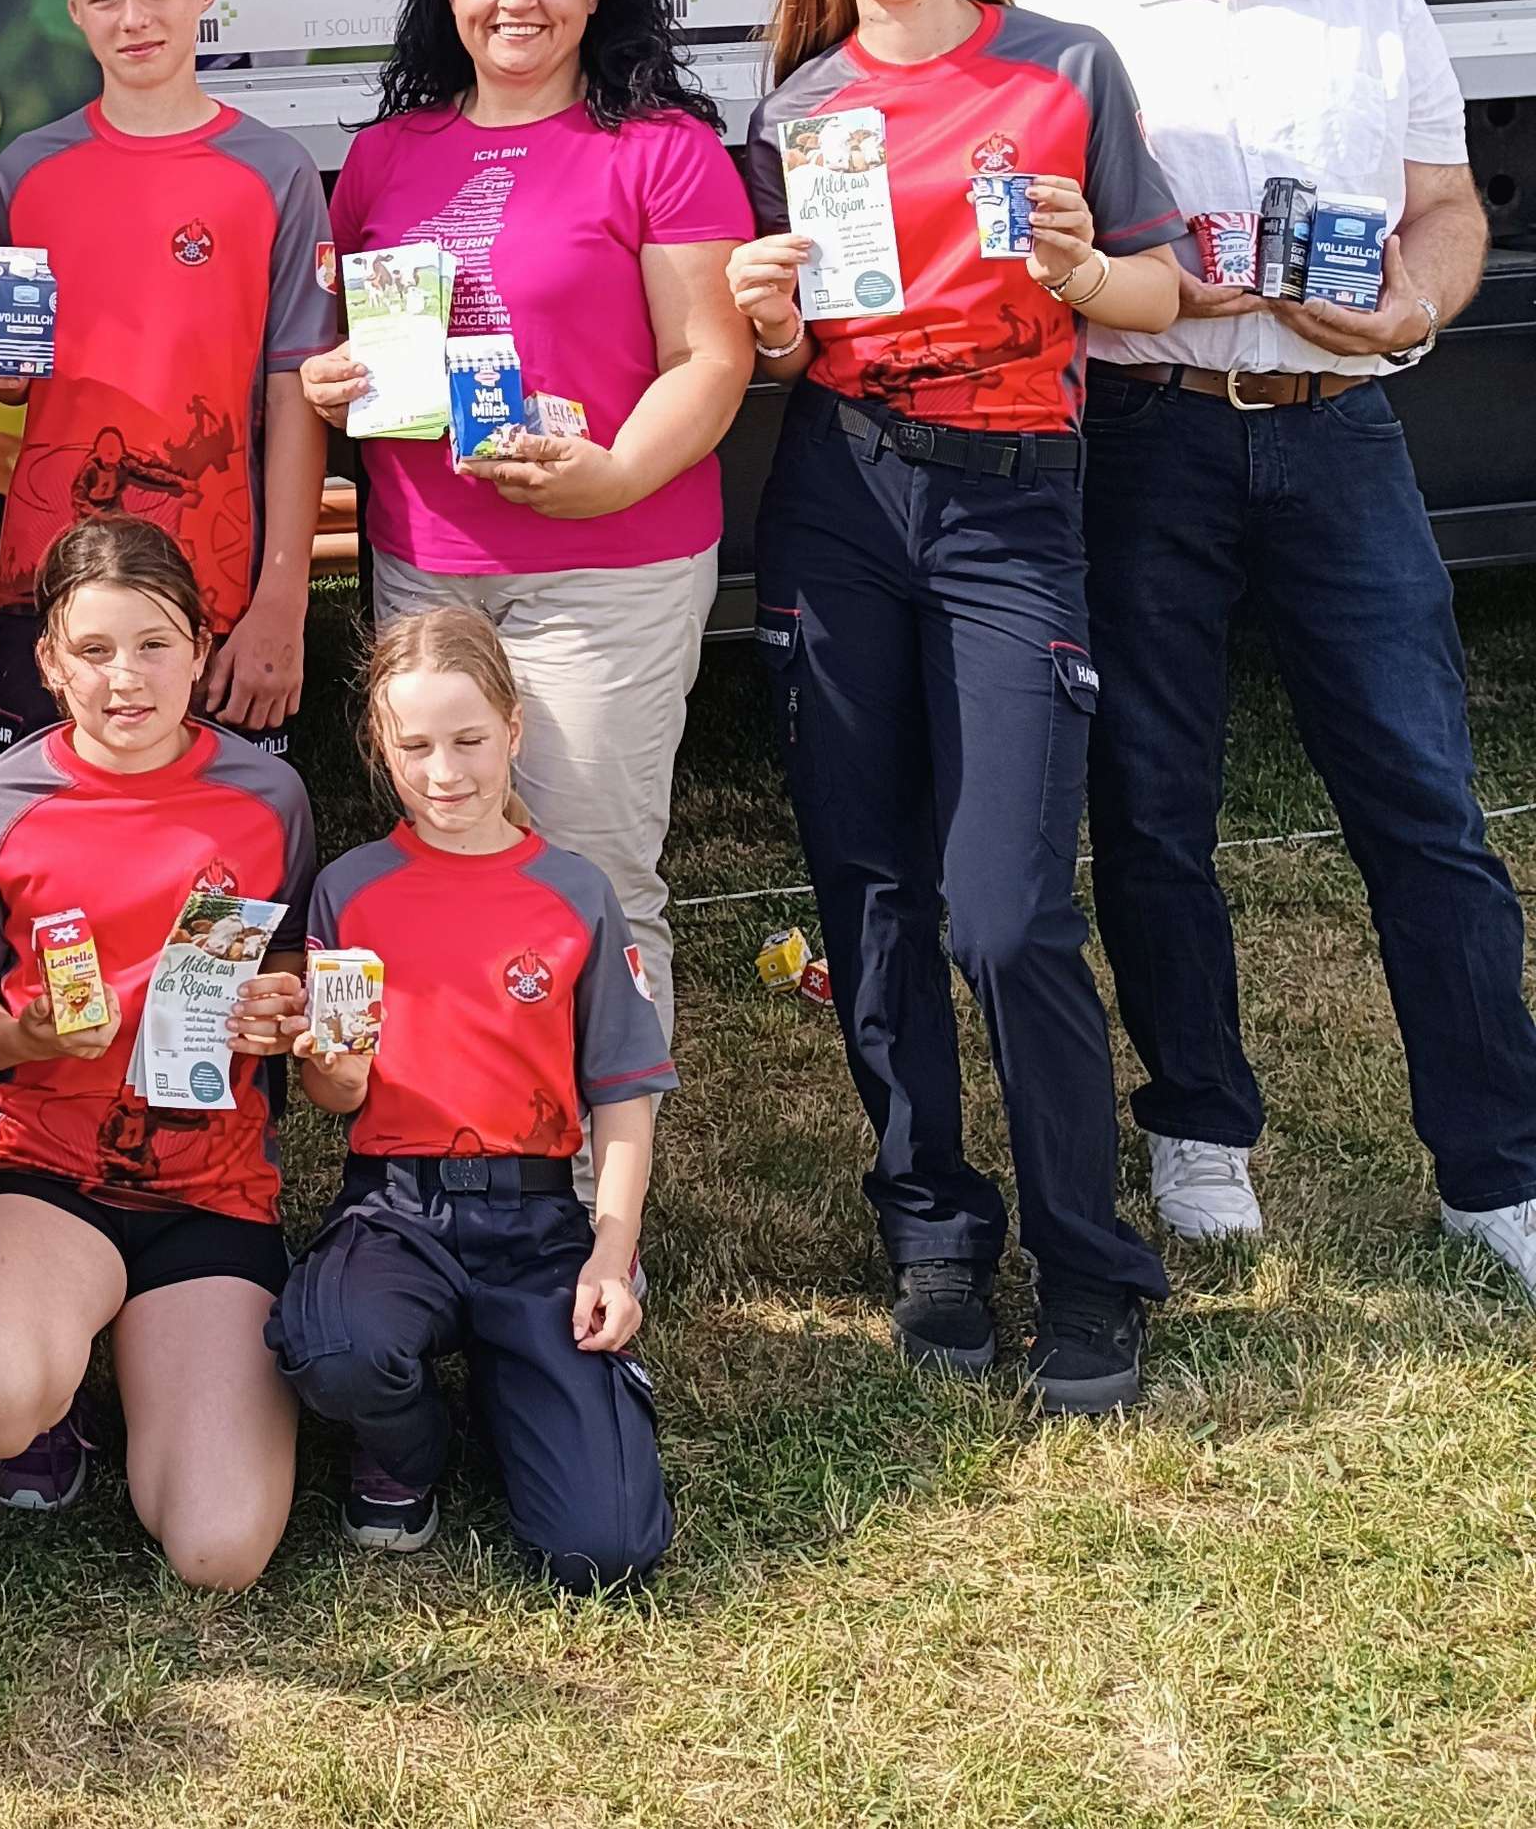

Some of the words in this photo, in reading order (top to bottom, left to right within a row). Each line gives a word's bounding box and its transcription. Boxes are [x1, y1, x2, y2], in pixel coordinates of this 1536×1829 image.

[472, 149, 498, 161] ICH
[501, 147, 527, 159] BIN
[809, 173, 848, 201] Milch
[800, 199, 820, 220] der
[822, 196, 865, 220] Region
[421, 235, 495, 251] ÄUERIN
[1316, 242, 1380, 259] VOLLMILCH
[475, 388, 503, 403] Voll
[472, 402, 509, 418] Milch
[545, 400, 581, 426] KAKAO
[169, 954, 213, 975] Milch
[216, 962, 237, 977] aus
[155, 971, 176, 992] der
[179, 972, 223, 1001] Region
[325, 974, 374, 1004] KAKAO
